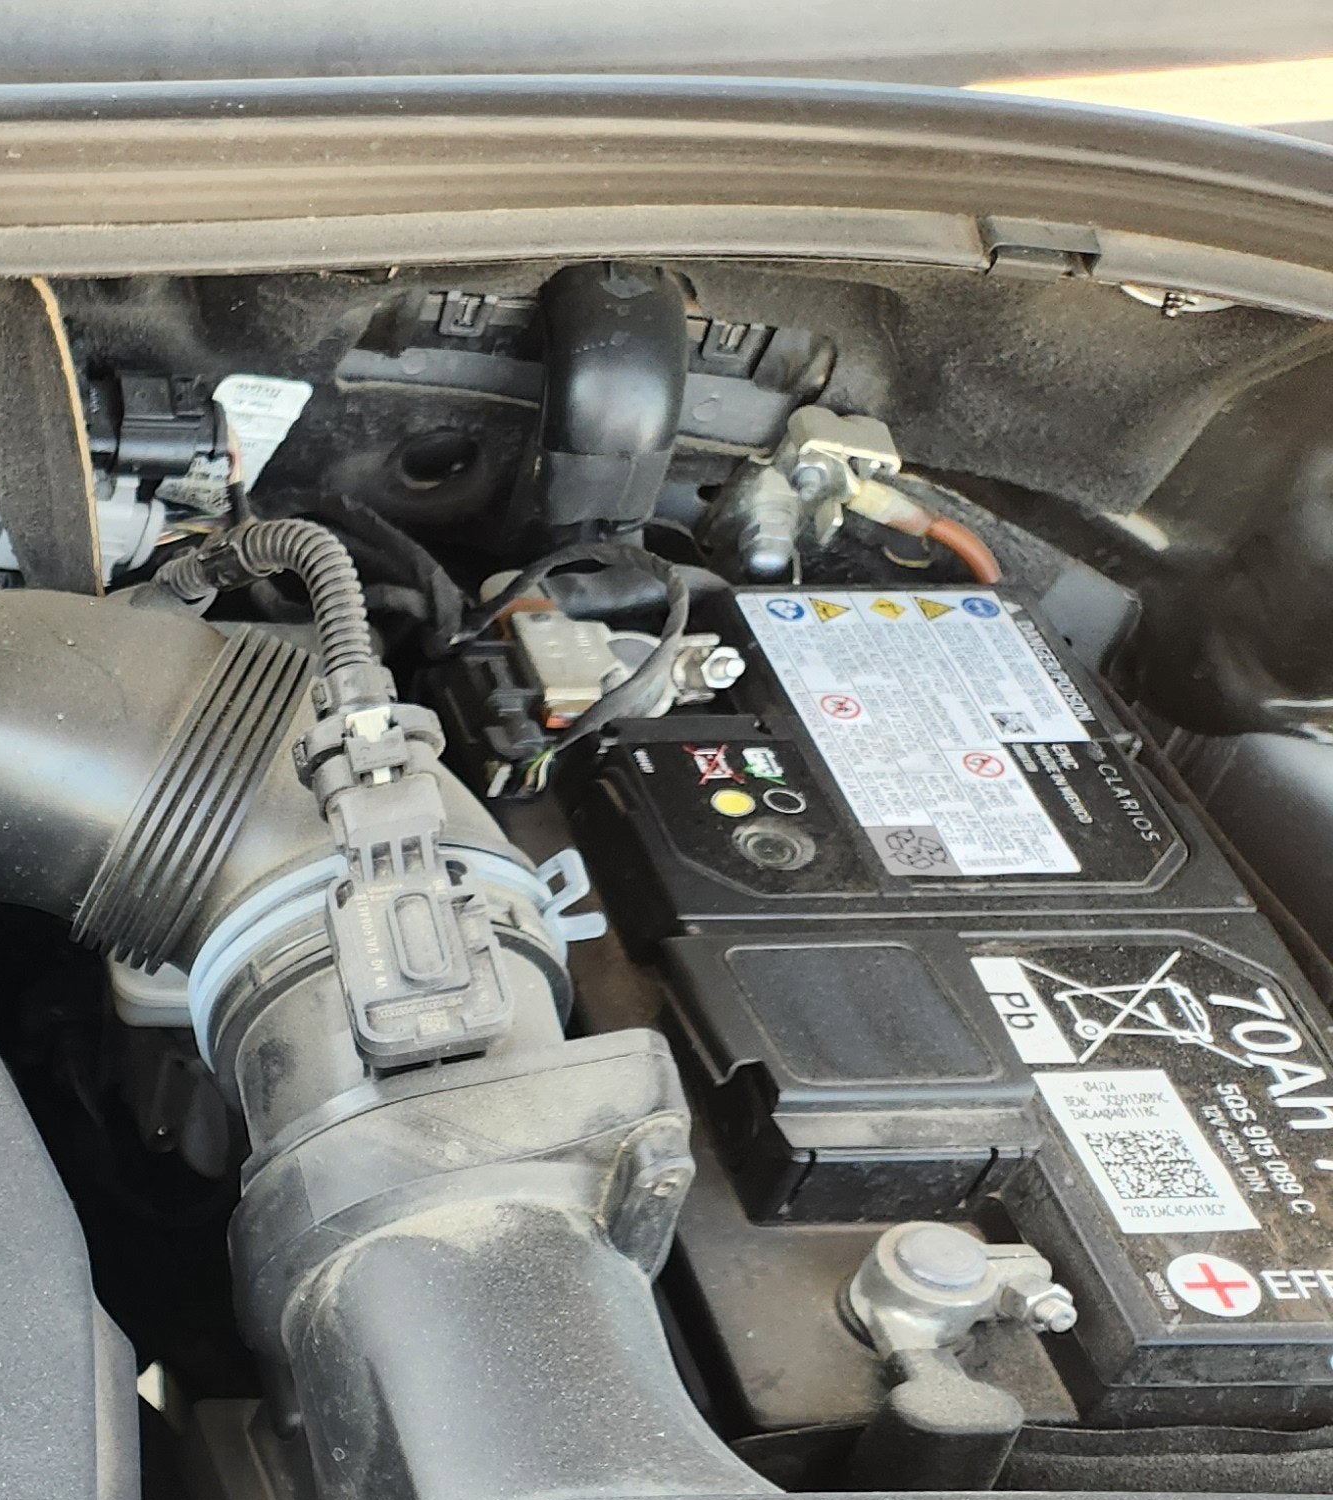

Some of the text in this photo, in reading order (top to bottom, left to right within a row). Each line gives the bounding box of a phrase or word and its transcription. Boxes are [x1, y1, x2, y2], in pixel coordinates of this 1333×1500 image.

[1098, 763, 1162, 843] CLARIOS
[986, 991, 1039, 1029] Pb
[1208, 987, 1333, 1130] 70Ah
[1239, 1166, 1272, 1193] DIN
[1242, 1124, 1282, 1158] 915
[1263, 1159, 1305, 1195] 089
[1289, 1198, 1316, 1214] C
